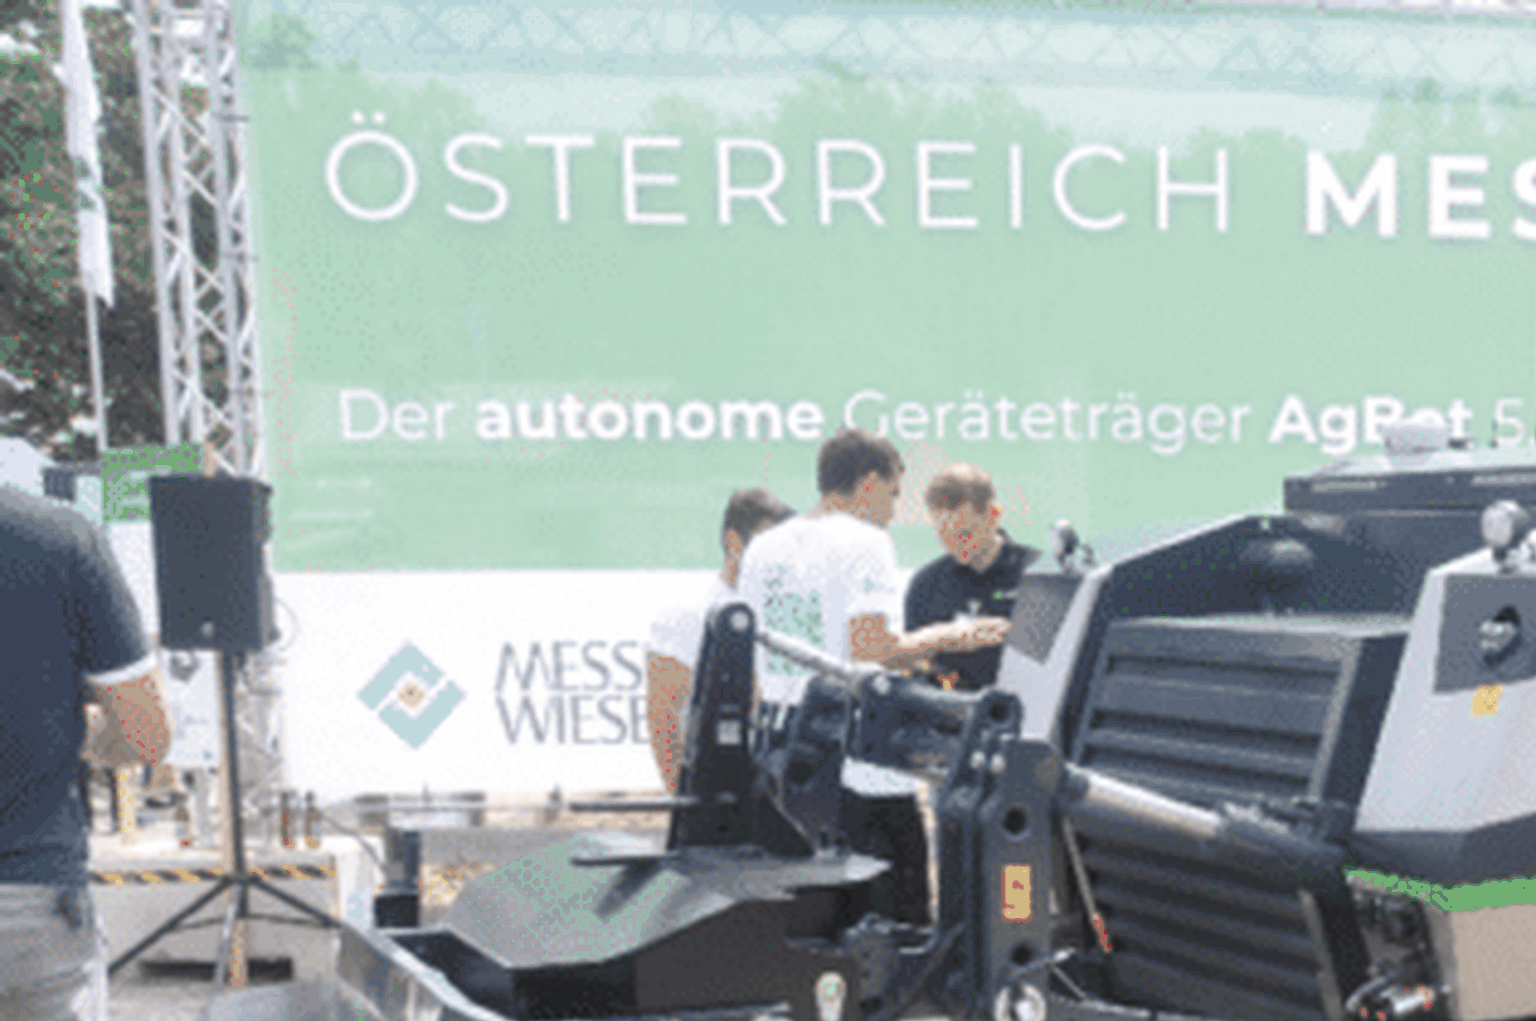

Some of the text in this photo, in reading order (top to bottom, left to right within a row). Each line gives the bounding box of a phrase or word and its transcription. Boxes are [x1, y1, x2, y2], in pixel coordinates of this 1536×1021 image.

[325, 110, 1231, 232] ÖSTERREICH
[338, 388, 456, 441] Der
[474, 390, 825, 441] autonome
[844, 390, 1251, 454] Geräteträger
[493, 640, 651, 692] MESS
